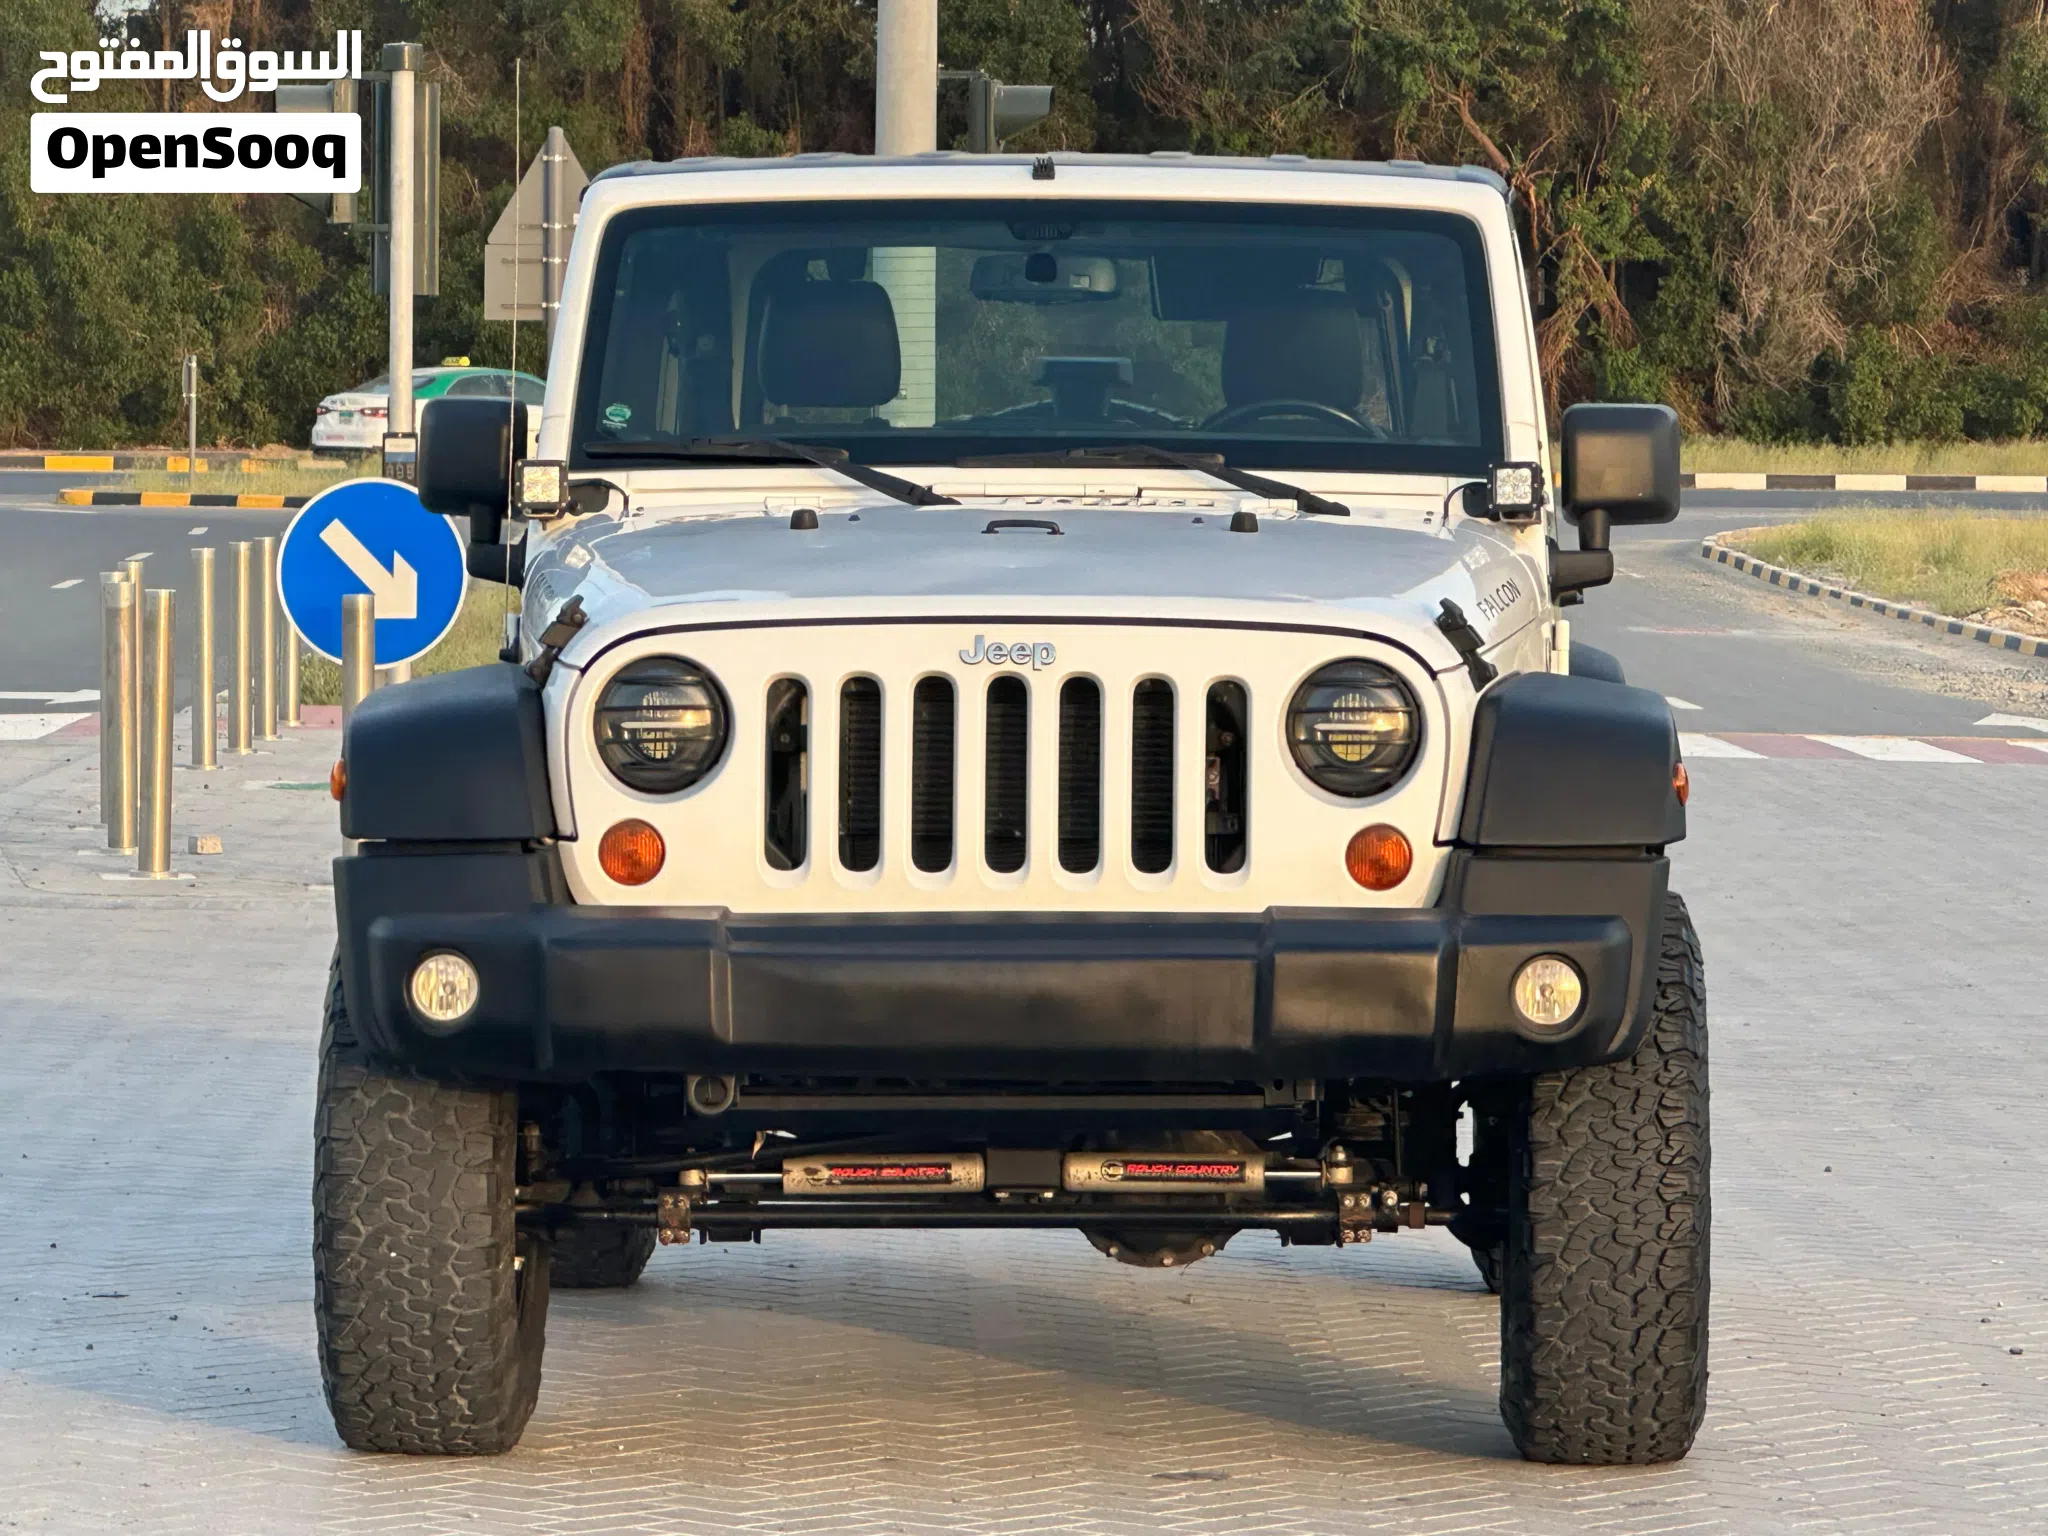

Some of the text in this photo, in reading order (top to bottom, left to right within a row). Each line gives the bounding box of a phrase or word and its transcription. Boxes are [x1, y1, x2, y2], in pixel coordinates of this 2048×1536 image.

[1476, 577, 1521, 621] FALCON
[959, 634, 1057, 671] Jeep
[832, 1166, 945, 1177] ROUGH COUNTRY
[1126, 1164, 1173, 1174] ROUGH
[1175, 1164, 1240, 1175] COUNTRY
